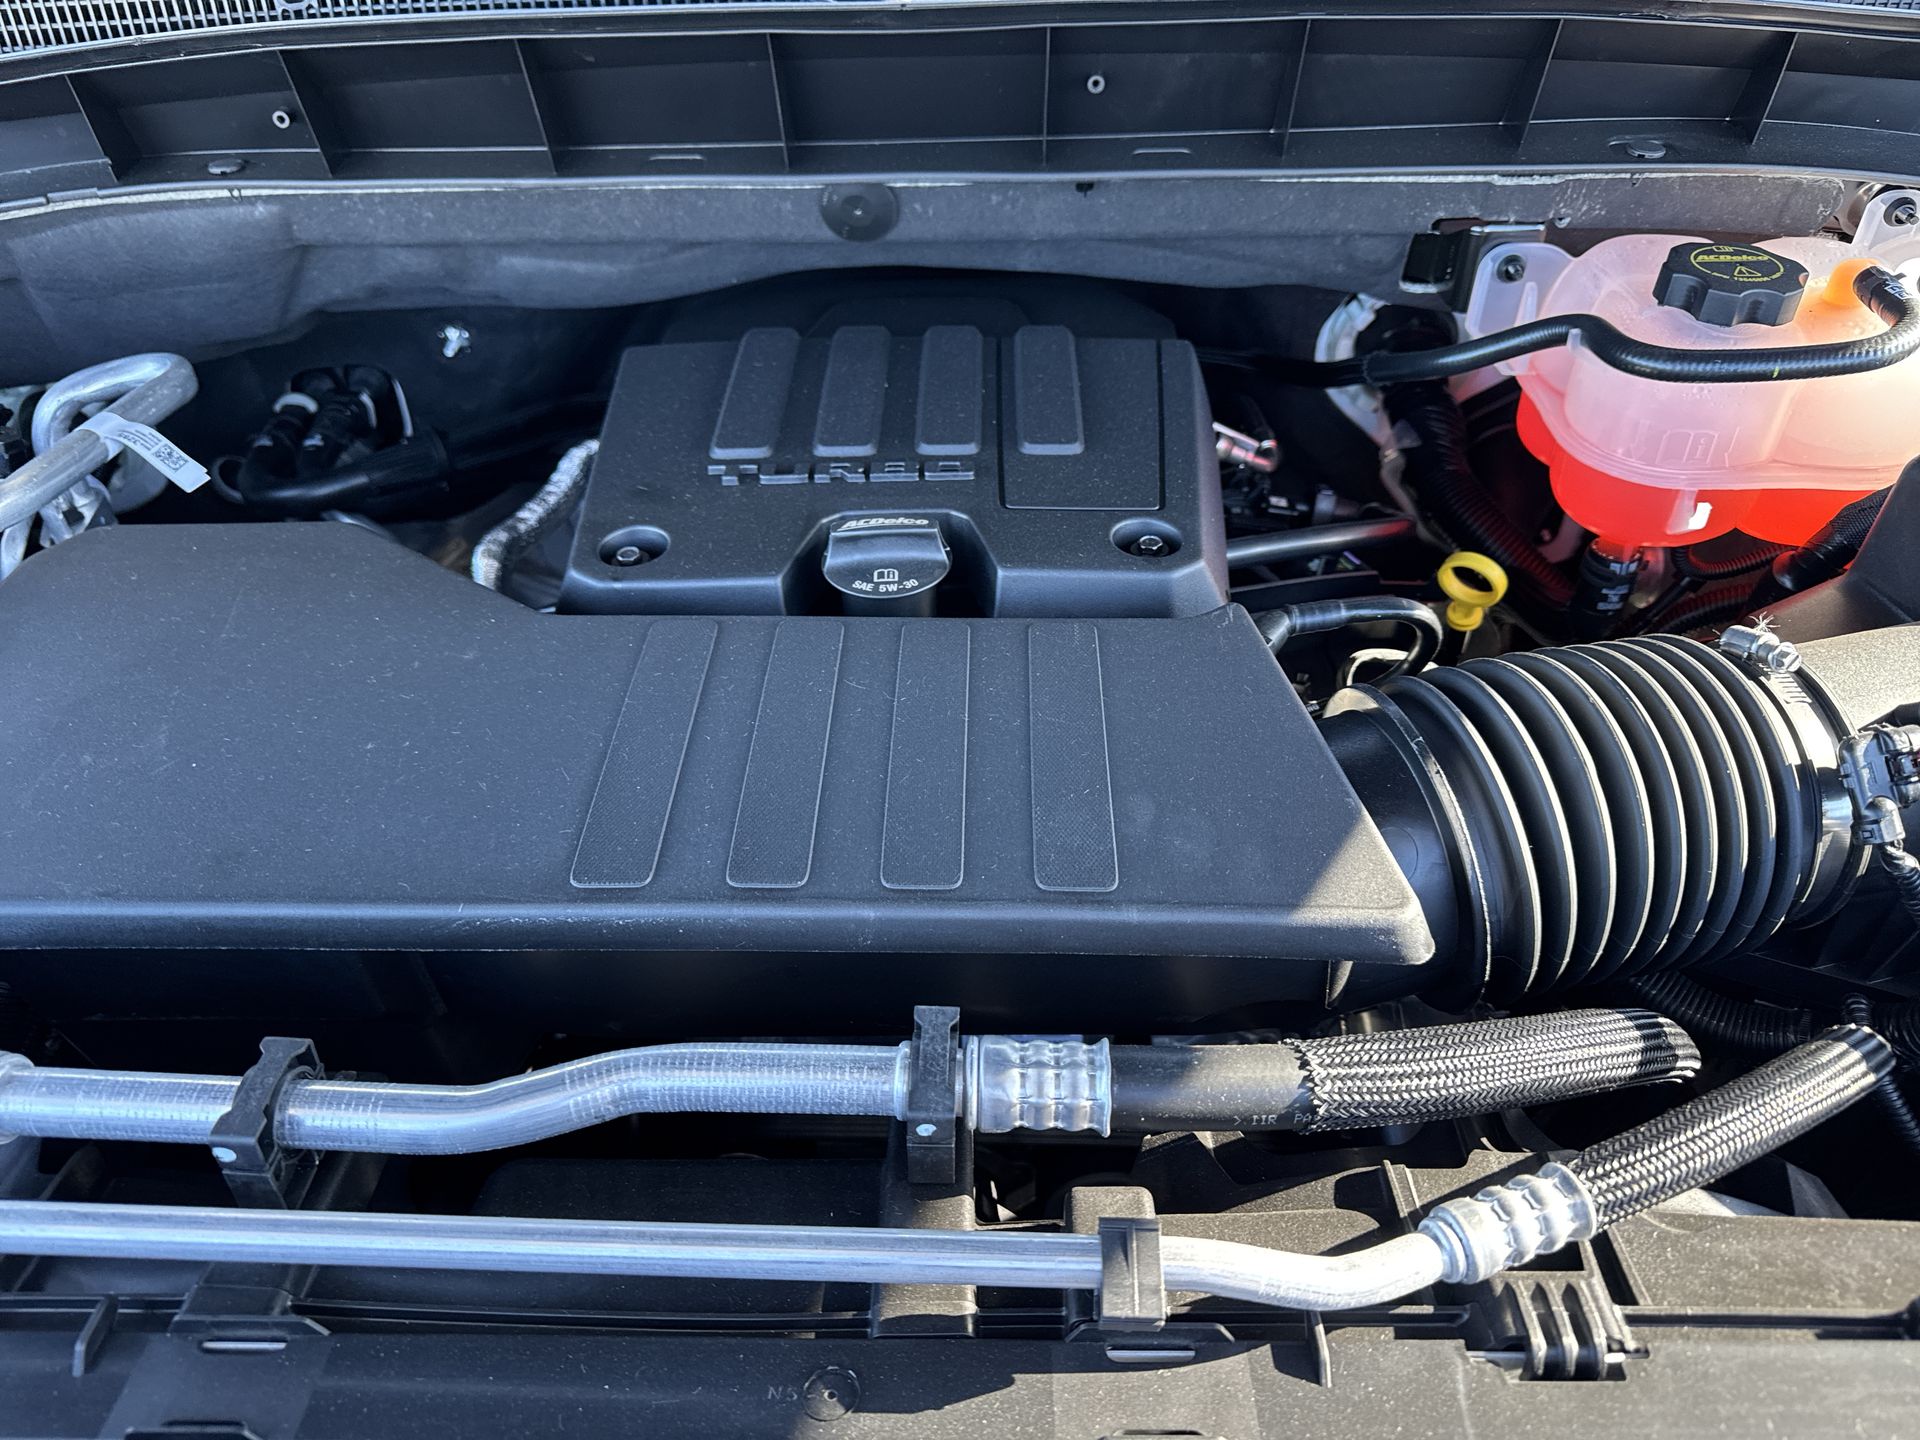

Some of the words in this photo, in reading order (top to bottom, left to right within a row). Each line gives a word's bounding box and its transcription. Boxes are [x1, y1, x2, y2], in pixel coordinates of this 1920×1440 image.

[1696, 254, 1769, 262] ACDelco
[707, 462, 975, 486] TURBO
[838, 517, 929, 531] ACDelco
[852, 580, 874, 591] SAE
[879, 579, 918, 592] 5W-30
